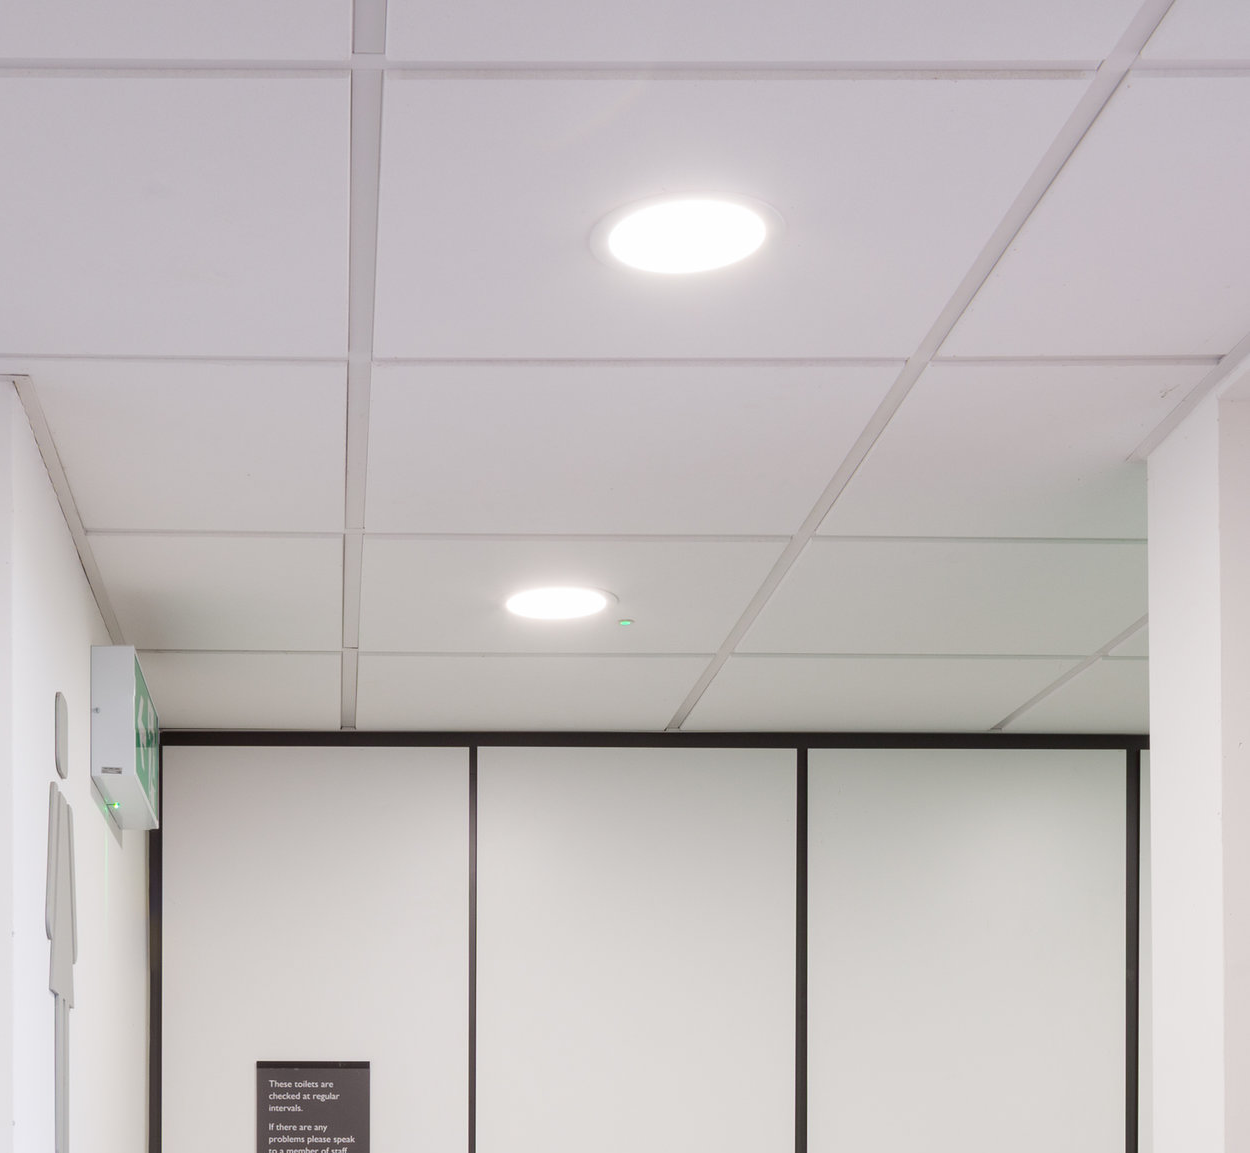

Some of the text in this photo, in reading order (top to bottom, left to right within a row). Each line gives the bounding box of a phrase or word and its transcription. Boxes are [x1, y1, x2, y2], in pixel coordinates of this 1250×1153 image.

[268, 1079, 293, 1088] These
[294, 1080, 319, 1088] toilets
[268, 1091, 301, 1100] checked
[312, 1092, 340, 1103] regular
[268, 1104, 303, 1112] intervals.
[268, 1122, 275, 1131] If
[275, 1123, 298, 1131] there
[313, 1124, 328, 1133] any
[268, 1135, 356, 1145] problems please speak
